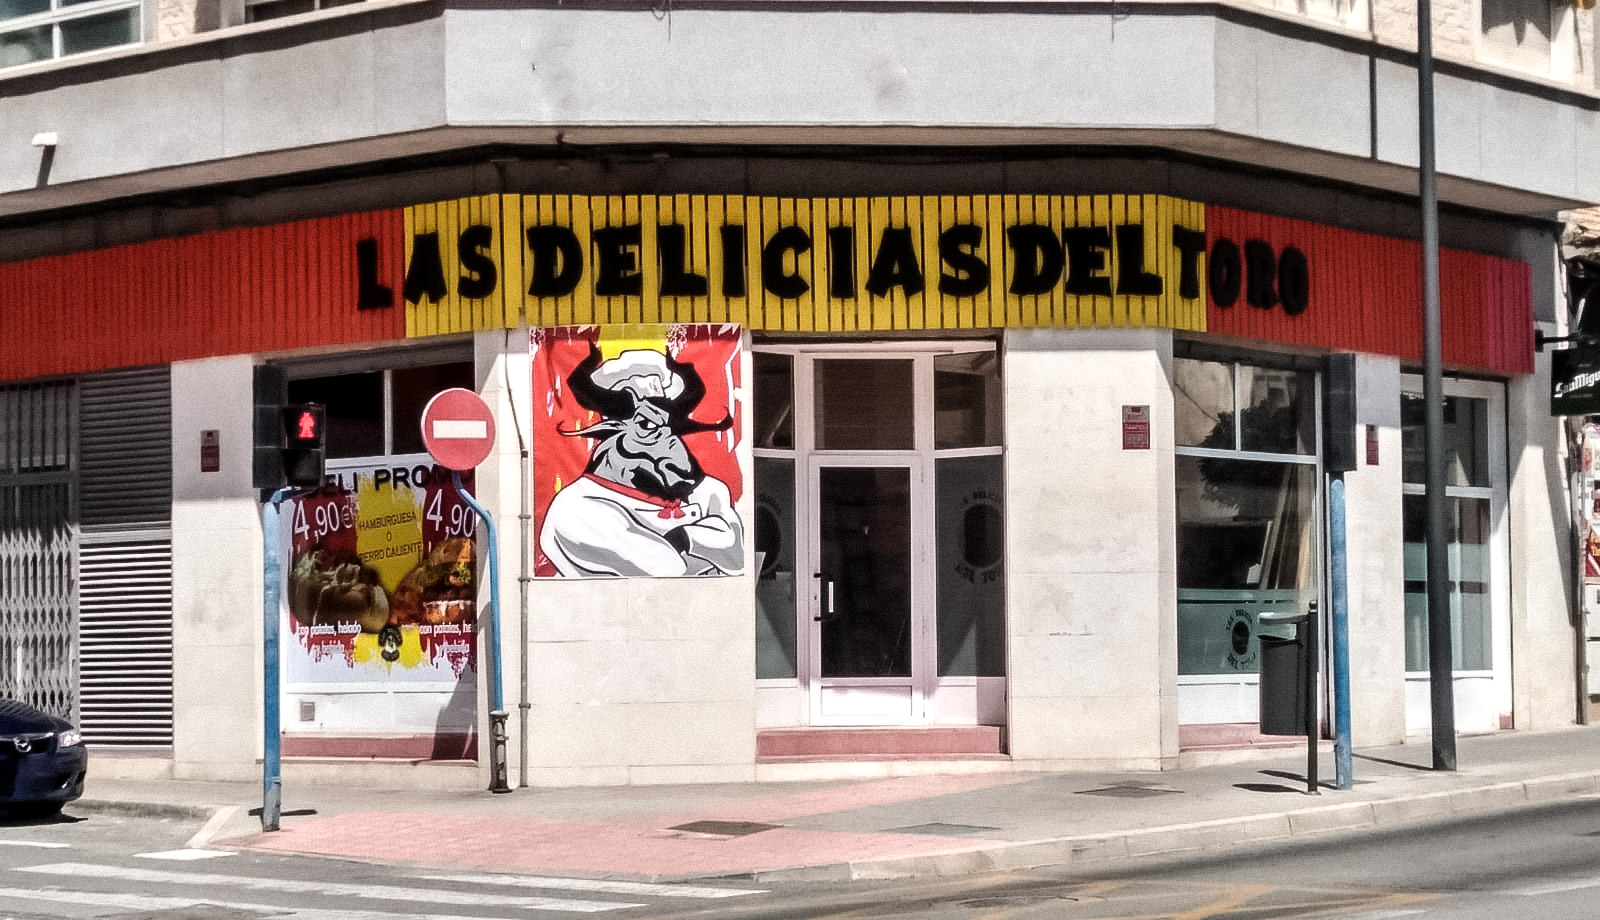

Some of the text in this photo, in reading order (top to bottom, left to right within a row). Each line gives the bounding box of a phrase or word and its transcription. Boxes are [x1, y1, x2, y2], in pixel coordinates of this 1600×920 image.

[357, 223, 1309, 316] LAS DELICIAS DEL TORO
[323, 471, 359, 496] ELI
